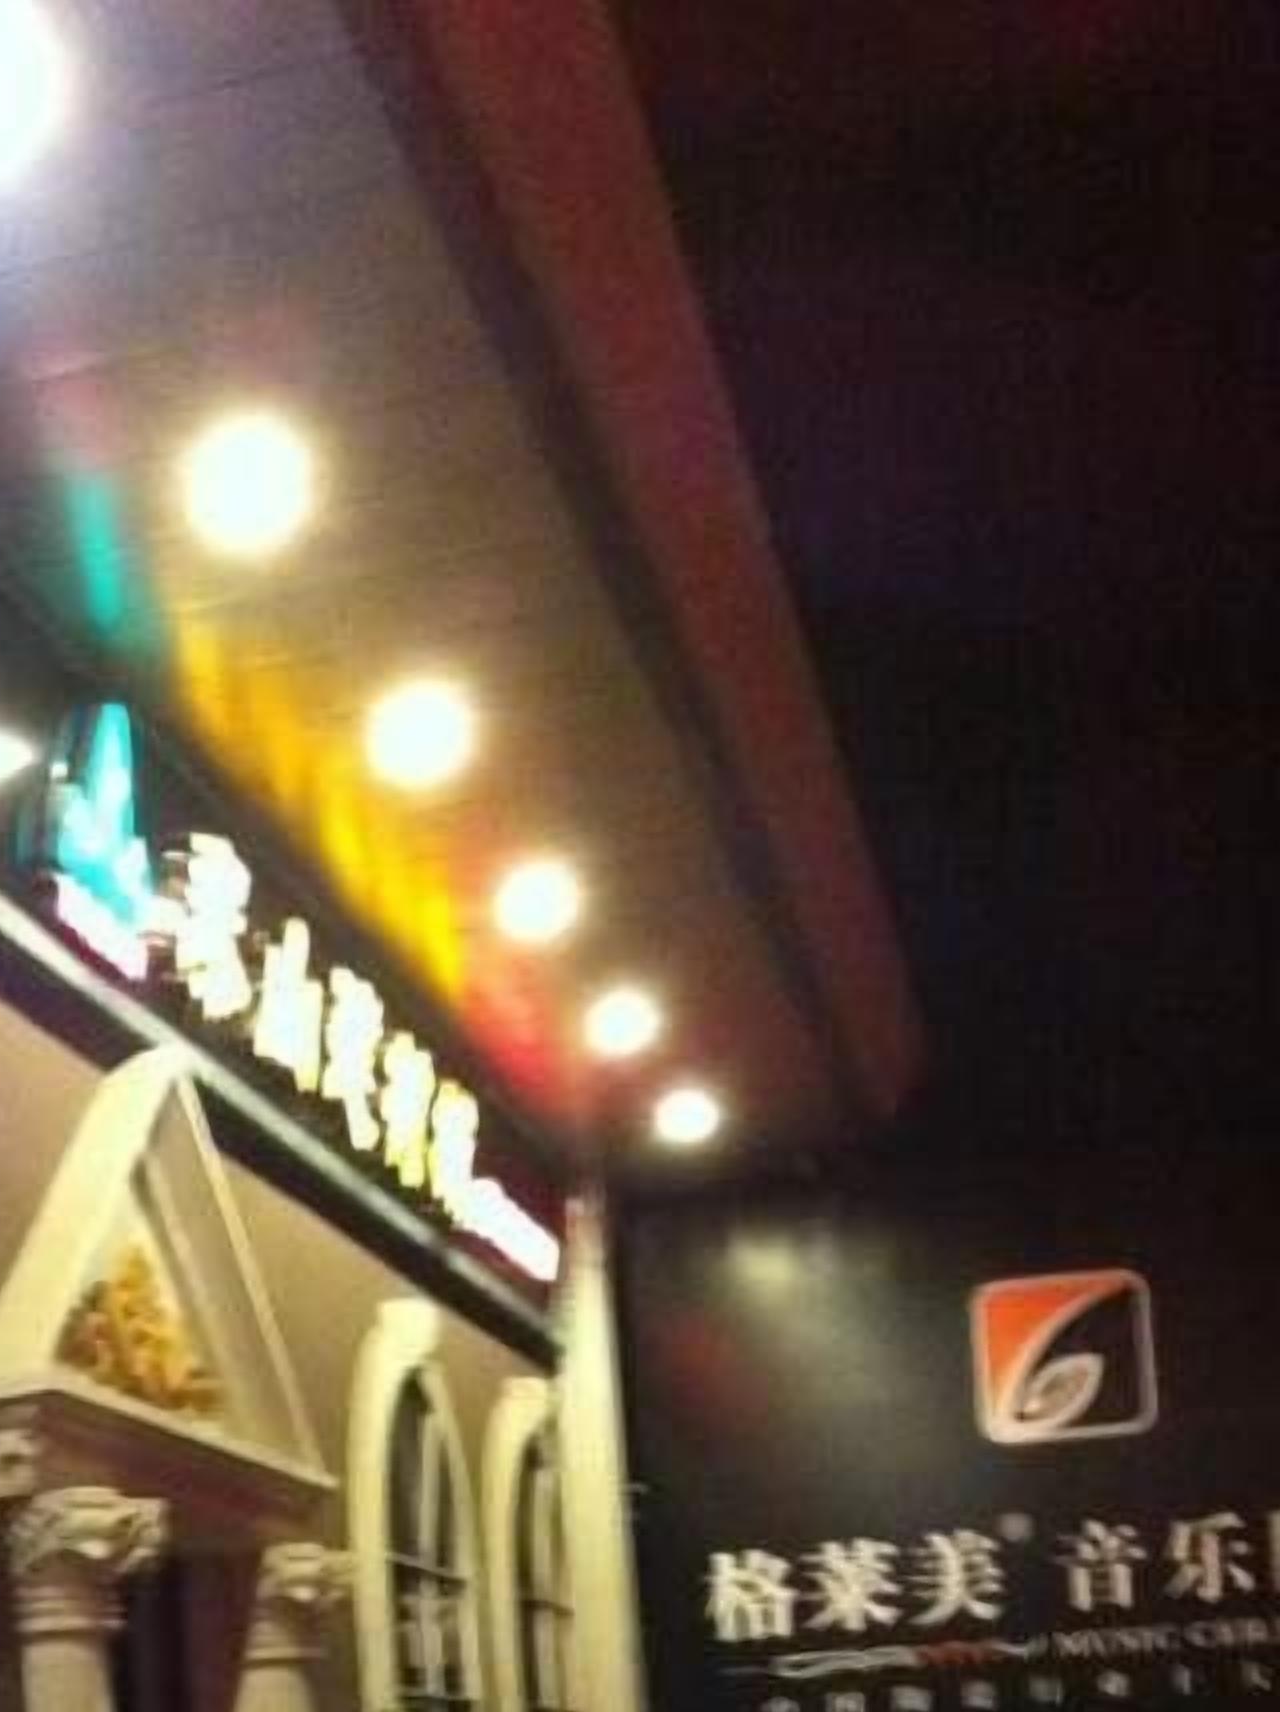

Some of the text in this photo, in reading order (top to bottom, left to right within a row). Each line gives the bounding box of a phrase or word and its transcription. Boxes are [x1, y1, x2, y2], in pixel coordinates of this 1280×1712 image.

[704, 1512, 1280, 1641] 格莱美 音乐
